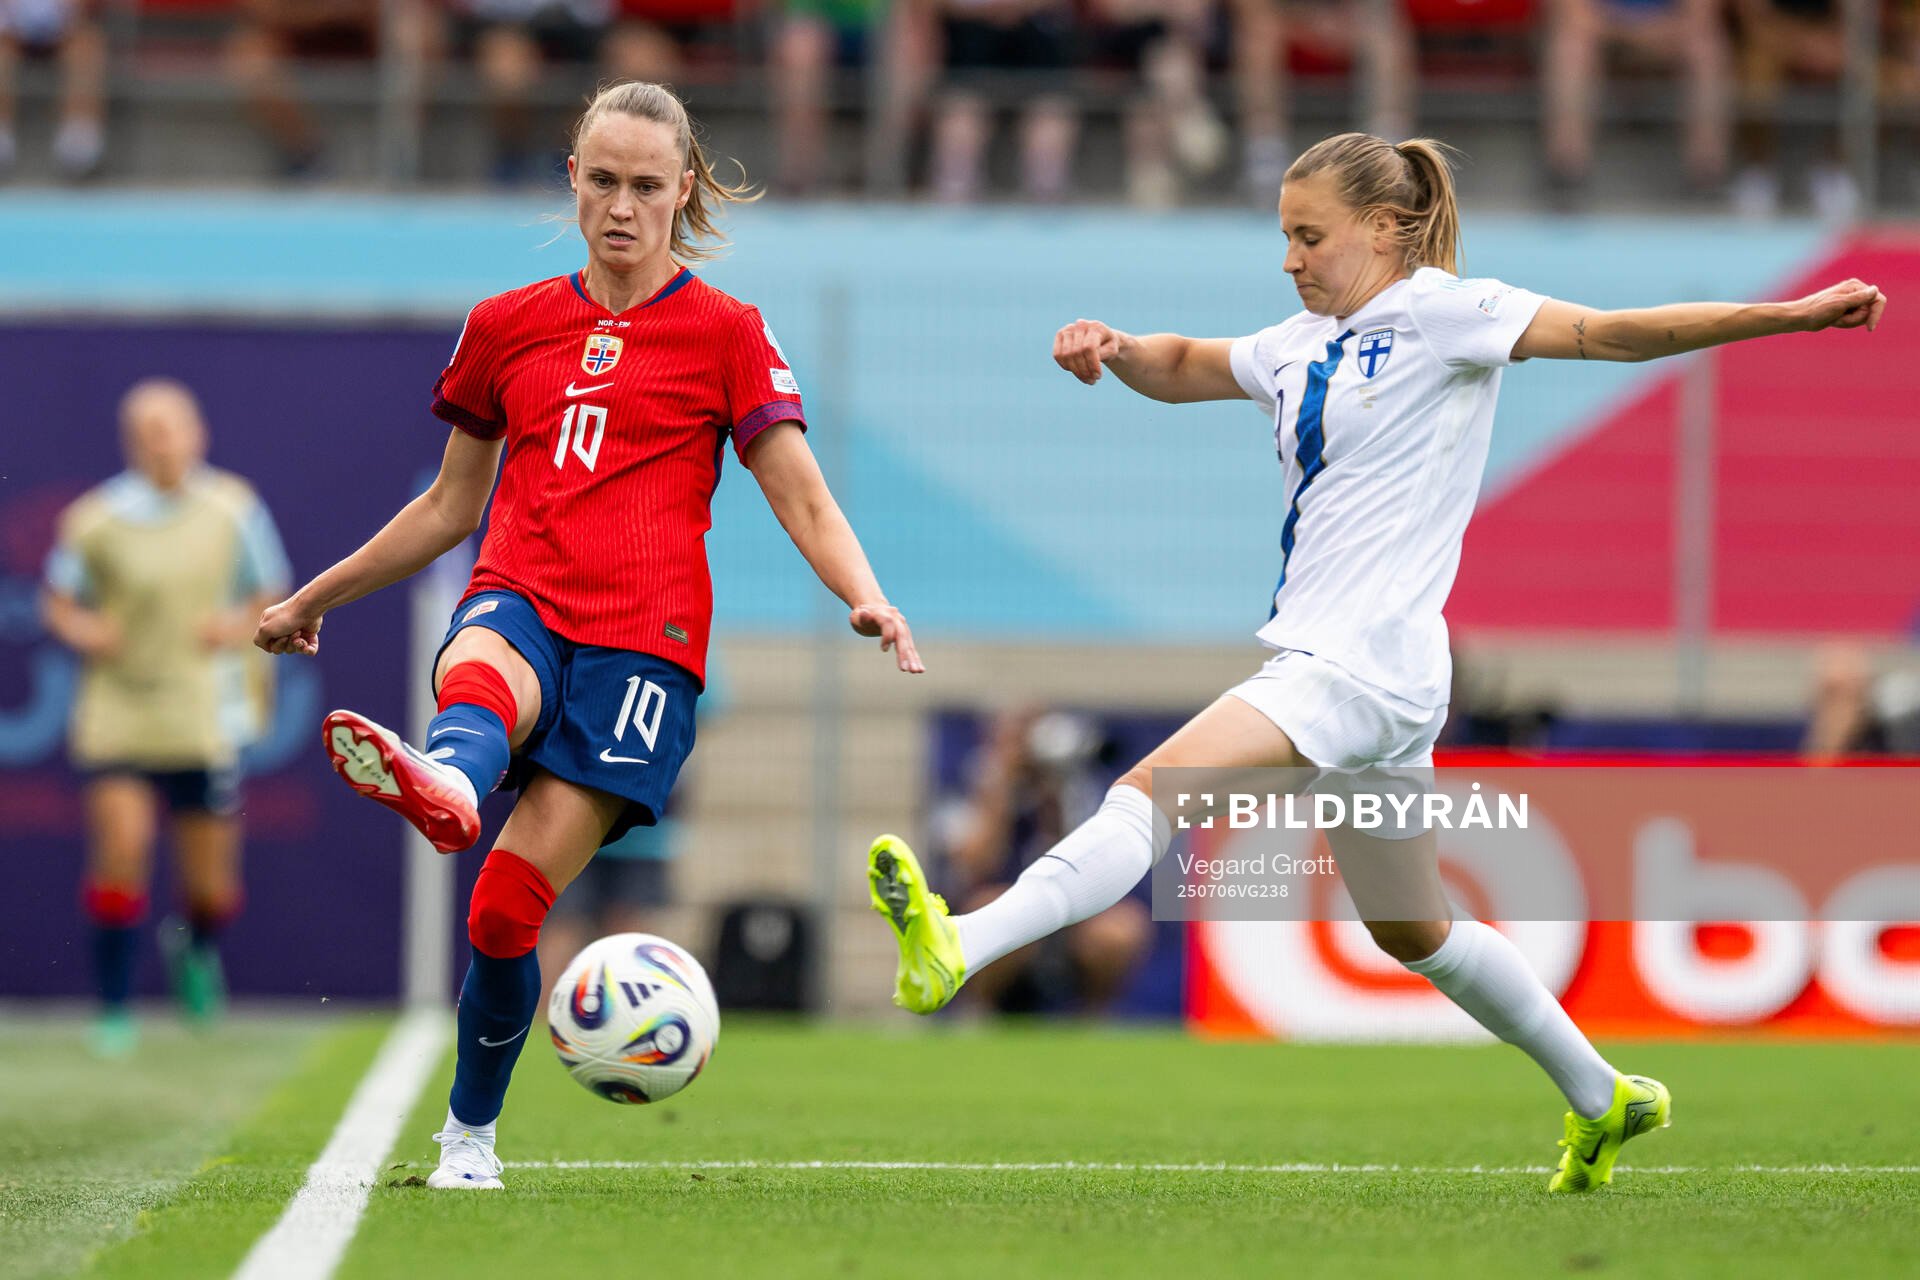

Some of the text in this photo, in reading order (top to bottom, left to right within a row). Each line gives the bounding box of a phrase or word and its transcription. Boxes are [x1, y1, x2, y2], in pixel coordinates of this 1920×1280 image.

[597, 319, 614, 327] NOR
[553, 404, 608, 472] 10
[613, 675, 667, 753] 10
